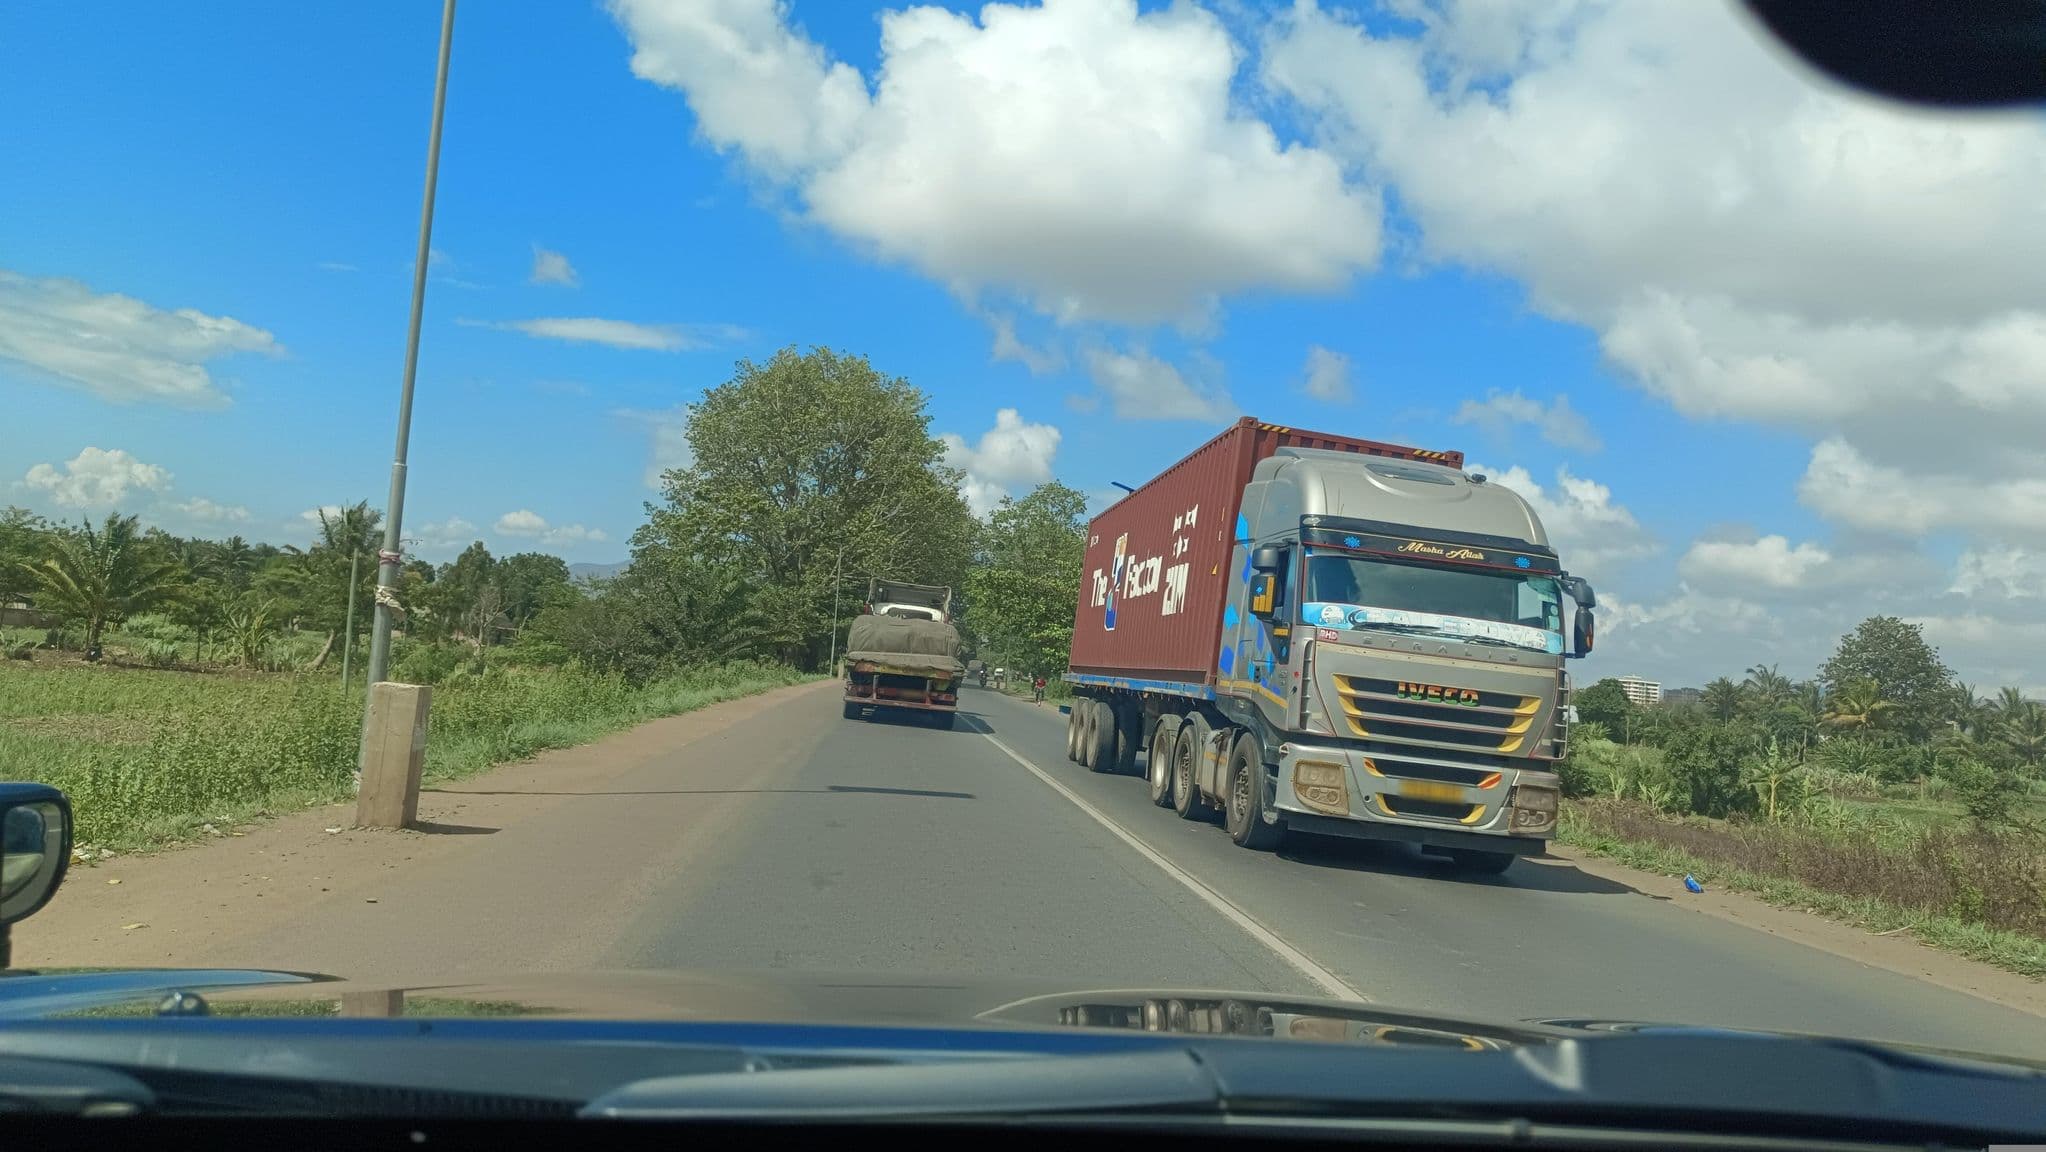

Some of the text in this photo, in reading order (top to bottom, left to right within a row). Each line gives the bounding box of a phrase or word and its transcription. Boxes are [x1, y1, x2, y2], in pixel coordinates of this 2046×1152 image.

[1397, 541, 1484, 560] Masha Allah
[1091, 568, 1108, 608] The
[1161, 562, 1190, 617] ZIM
[1397, 681, 1479, 707] IVECO
